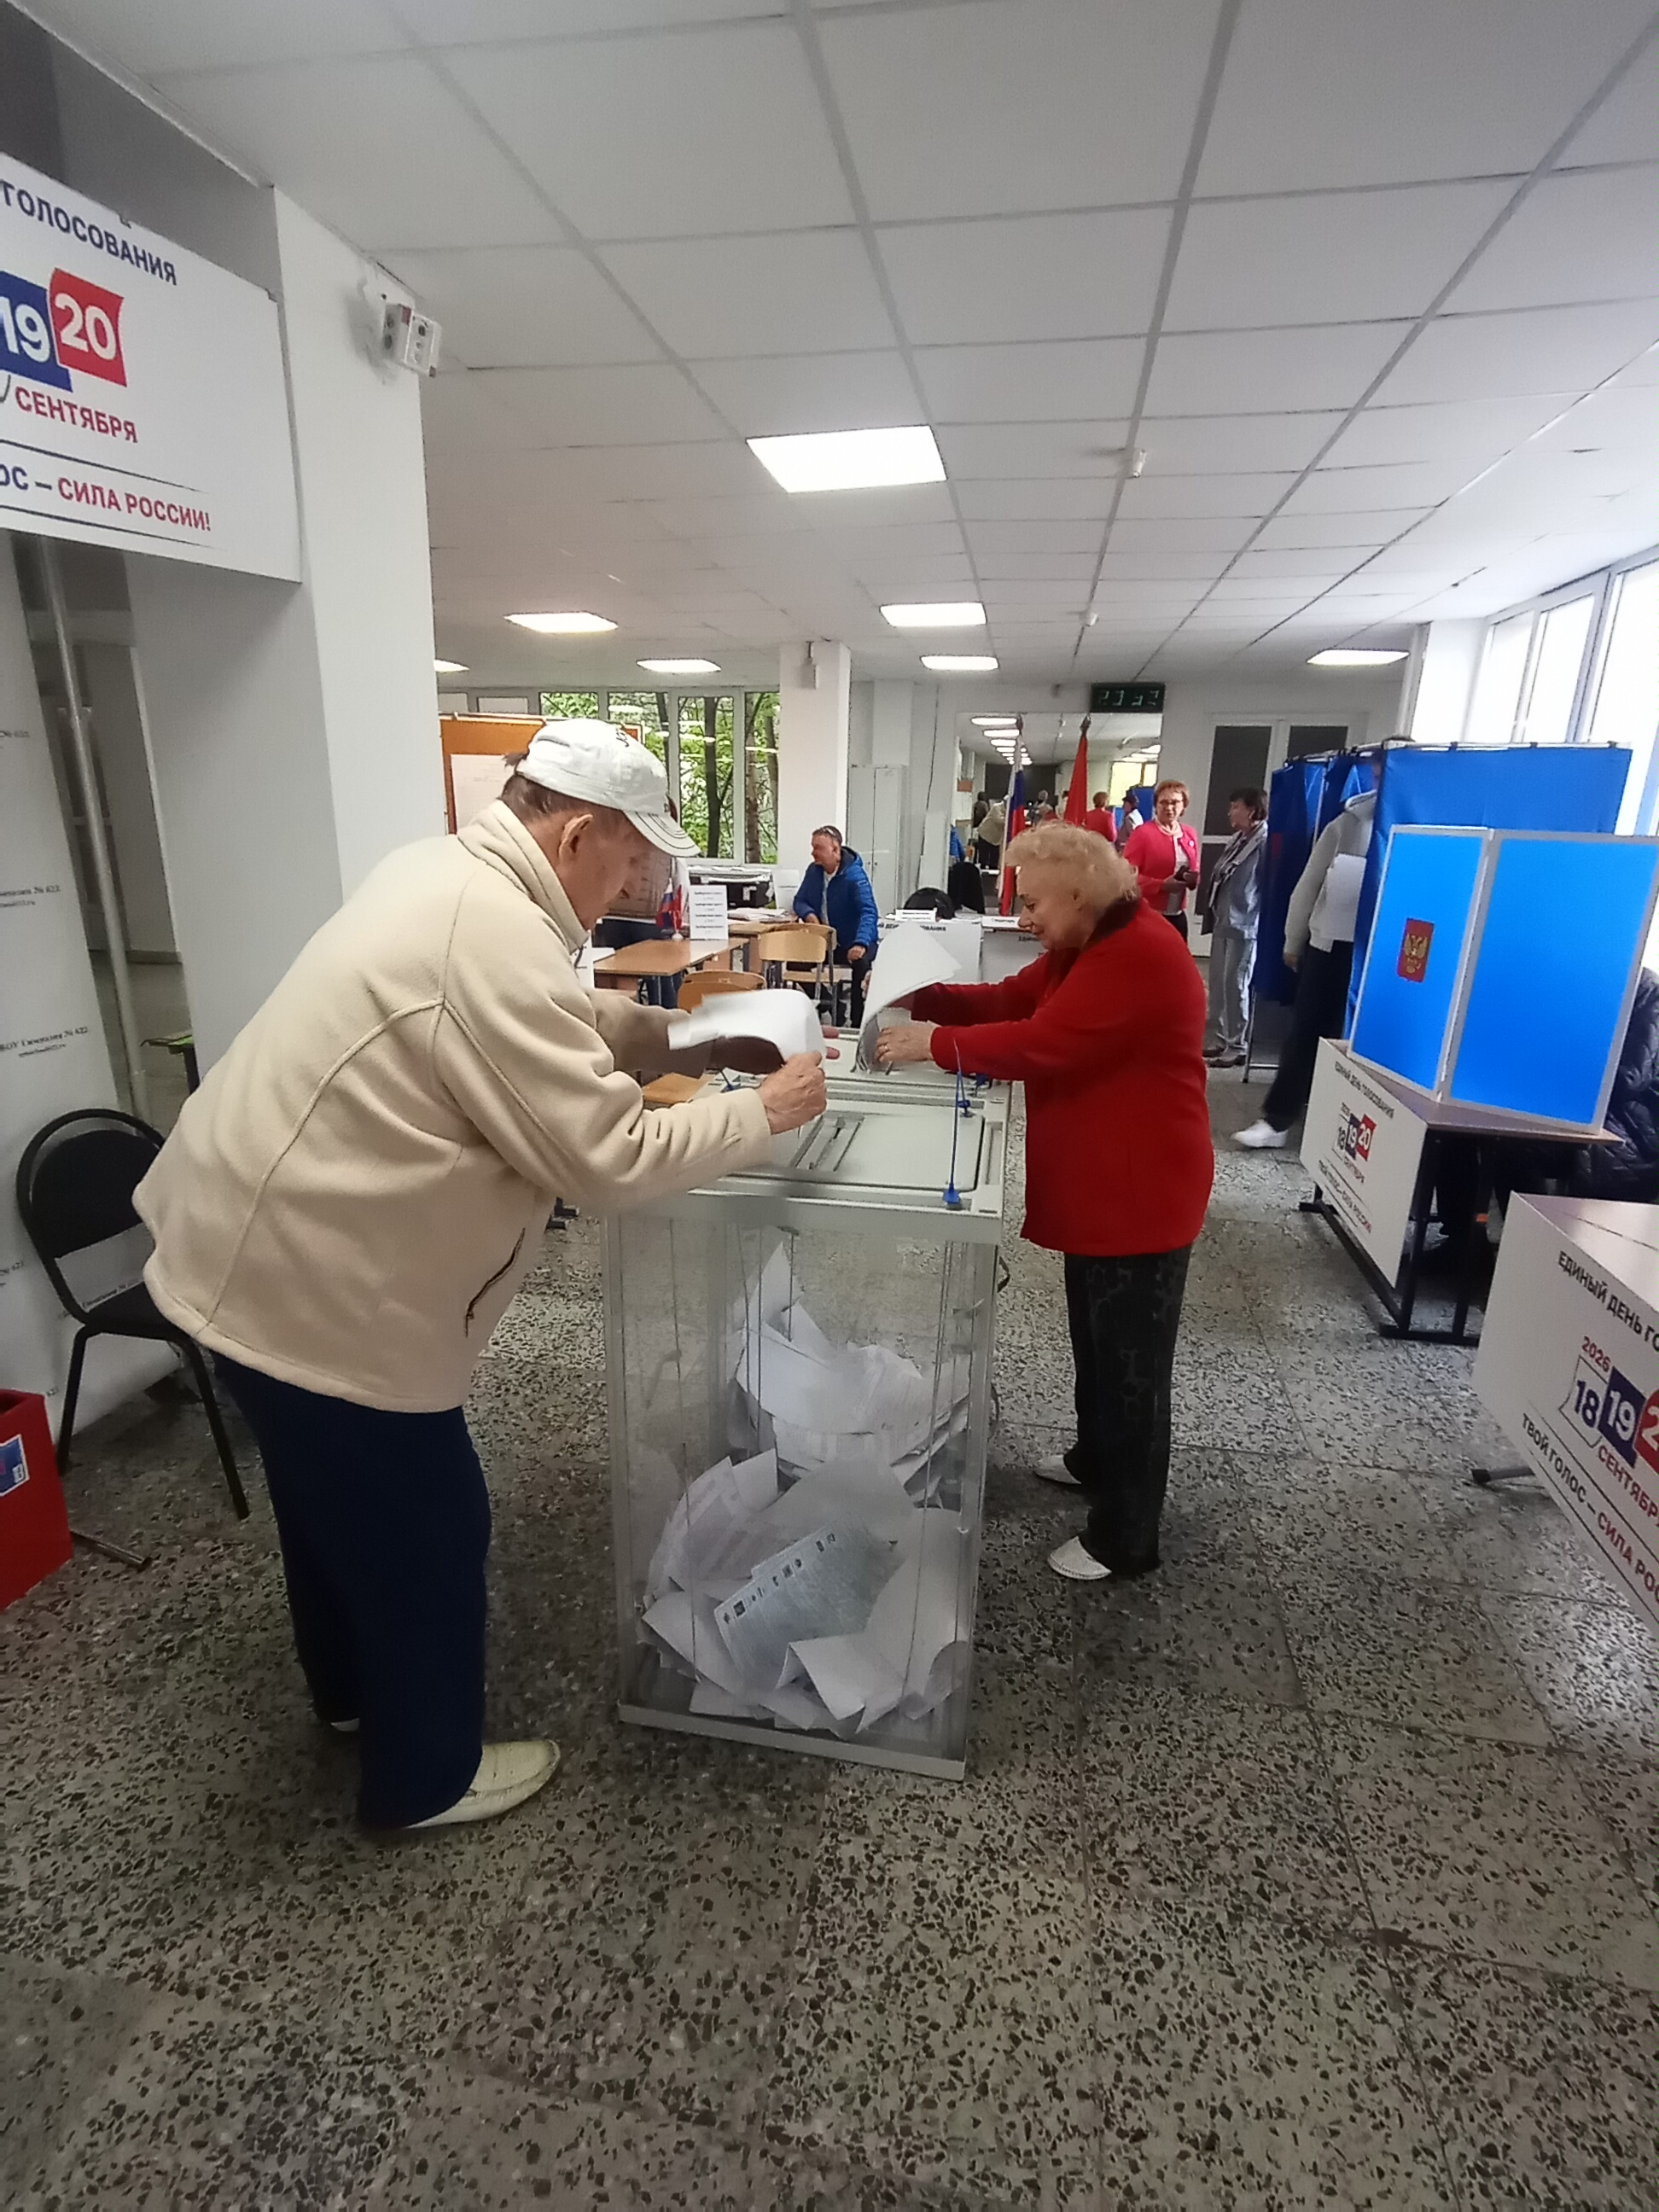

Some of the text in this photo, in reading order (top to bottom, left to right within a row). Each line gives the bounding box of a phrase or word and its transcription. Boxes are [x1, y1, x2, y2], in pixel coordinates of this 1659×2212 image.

[2, 180, 177, 286] ГОЛОСОВАНИЯ
[0, 293, 117, 363] 19 20
[15, 387, 138, 443] СЕНТЯБРЯ
[58, 478, 121, 511] СИЛА
[125, 492, 211, 531] РОССИИ!
[1348, 1124, 1357, 1149] 19
[1358, 1123, 1371, 1150] 20
[1558, 1250, 1608, 1304] ЕДИНЫЙ
[1606, 1294, 1643, 1336] ДЕНЬ
[1581, 1336, 1611, 1373] 2026
[1575, 1380, 1600, 1429] 18
[1607, 1390, 1636, 1441] 19
[1522, 1413, 1550, 1456] ТВОЙ
[1548, 1447, 1586, 1503] ГОЛОС
[1598, 1512, 1633, 1564] СИЛА
[1598, 1445, 1659, 1528] СЕНТЯБР
